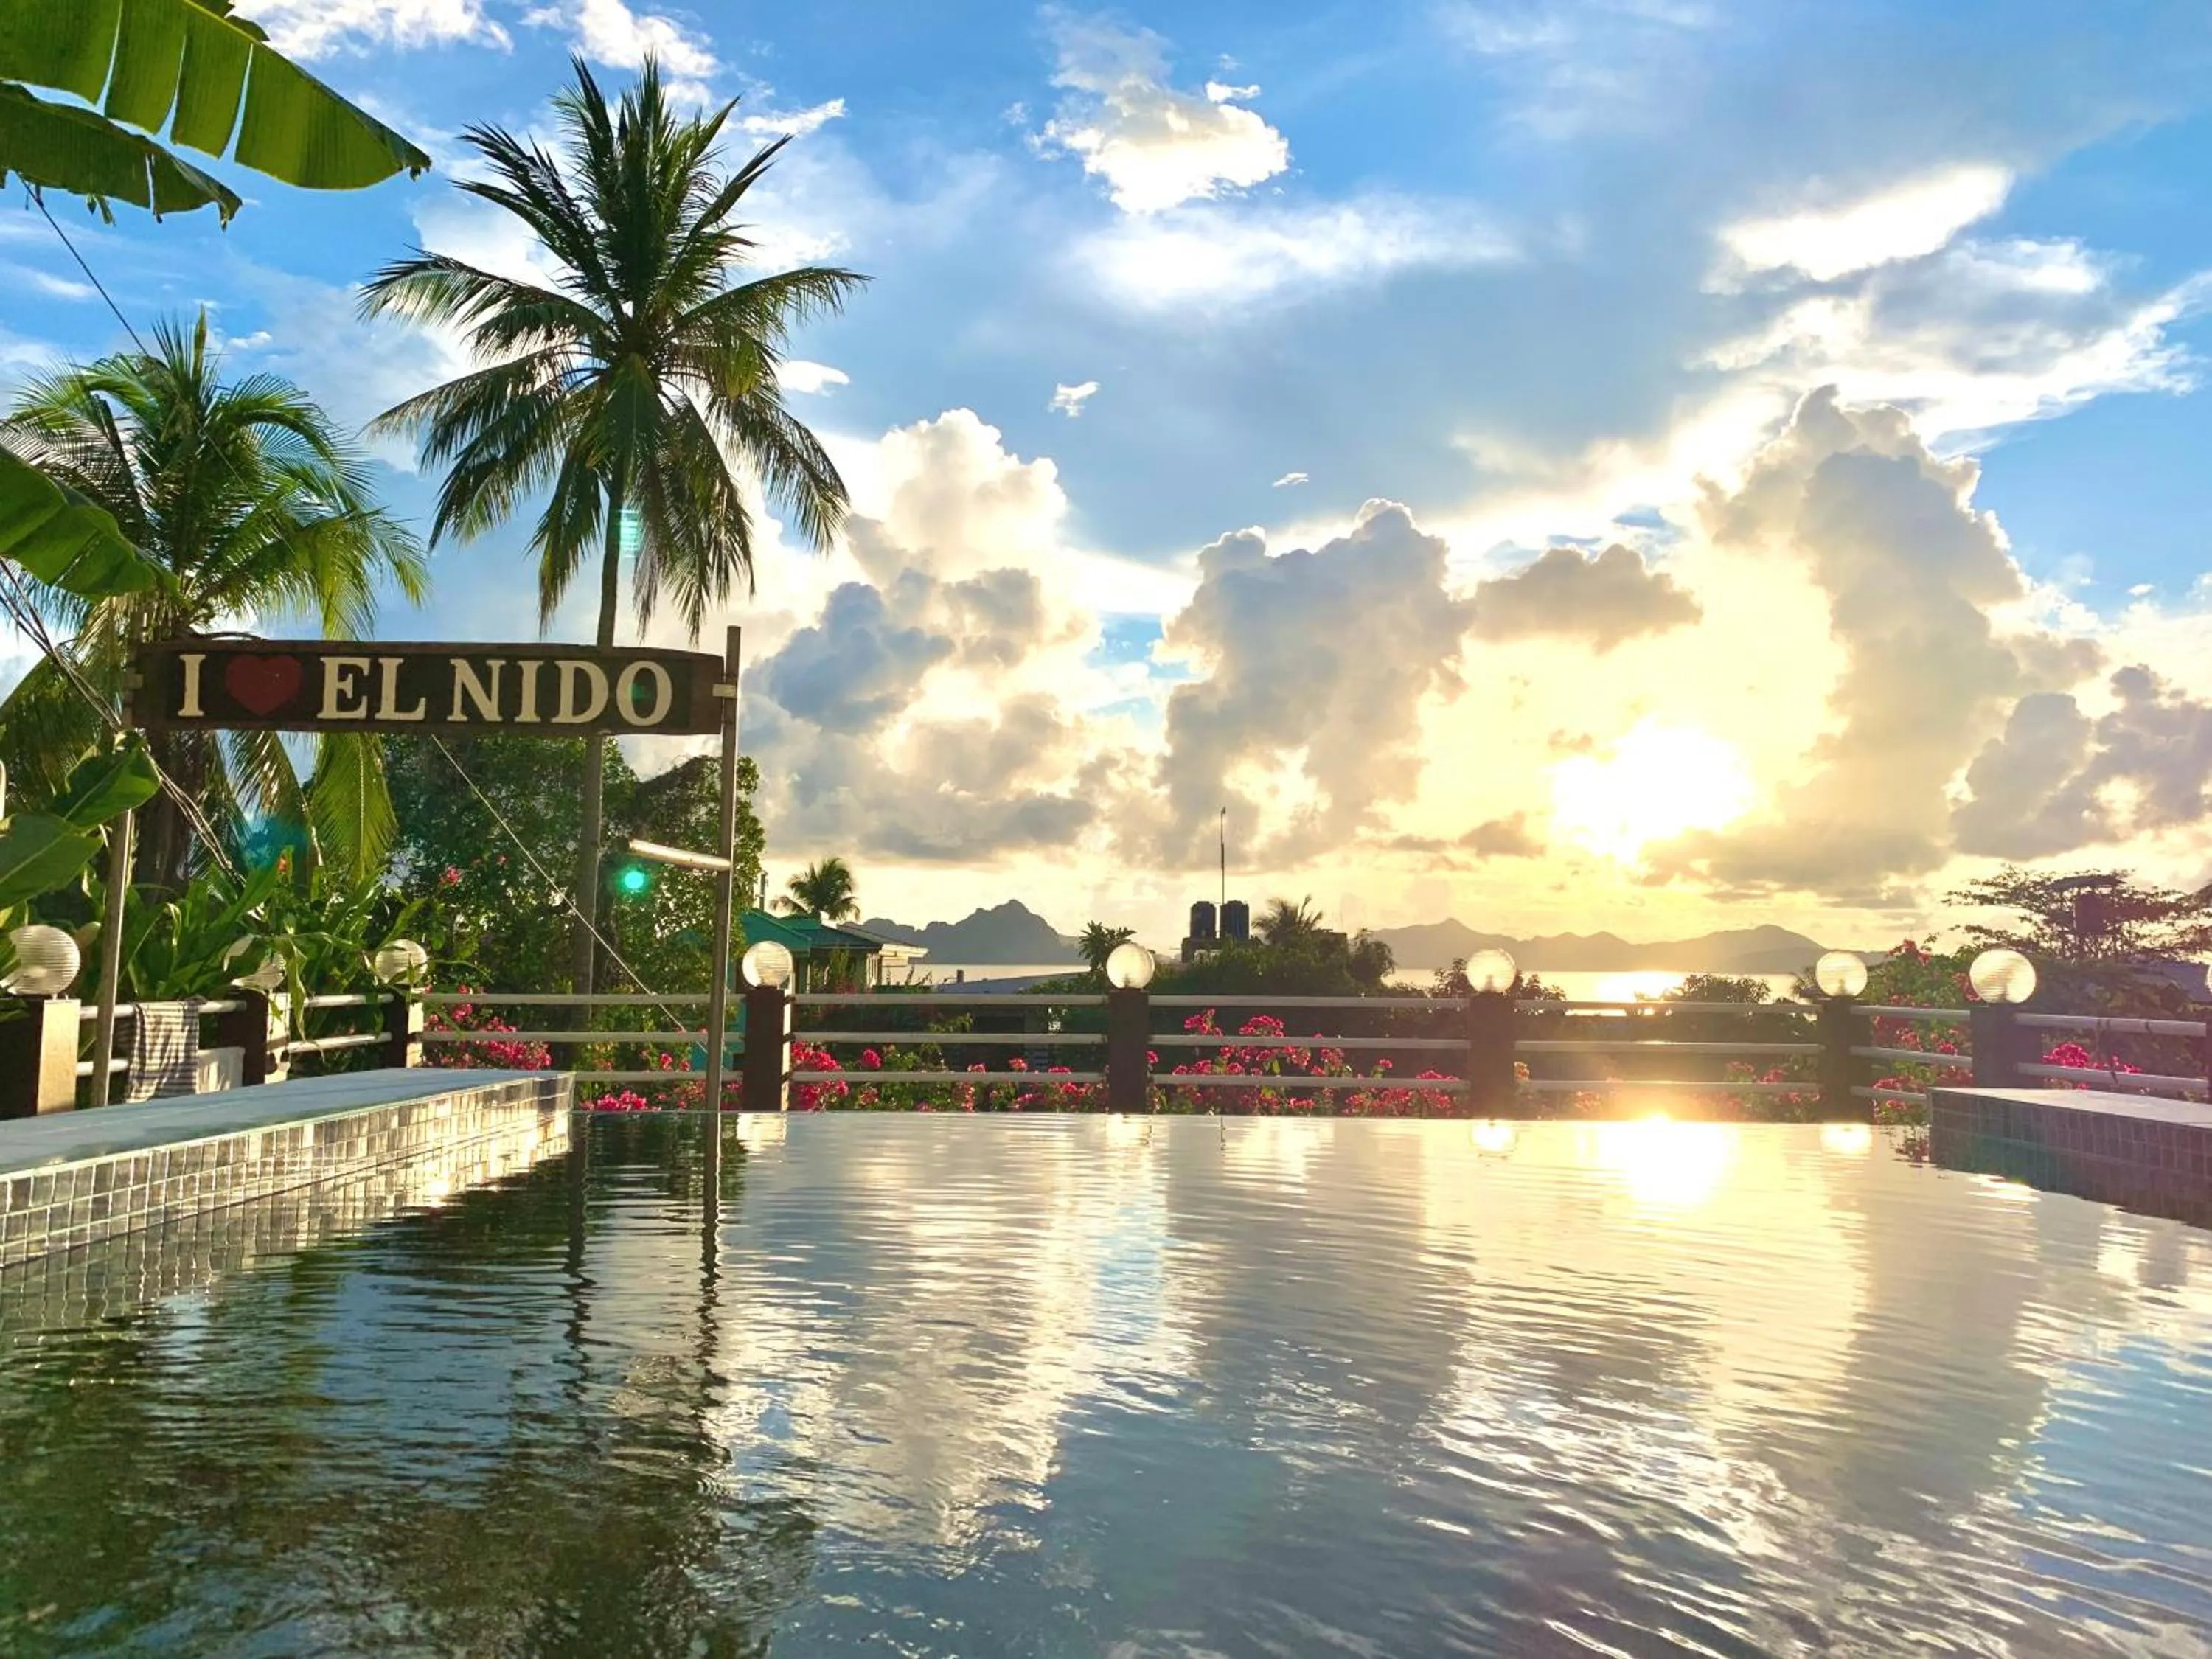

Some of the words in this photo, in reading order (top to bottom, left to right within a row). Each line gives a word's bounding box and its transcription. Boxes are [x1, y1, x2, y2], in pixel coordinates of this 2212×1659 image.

[178, 654, 204, 717] I
[317, 656, 426, 720] EL
[448, 658, 673, 726] NIDO
